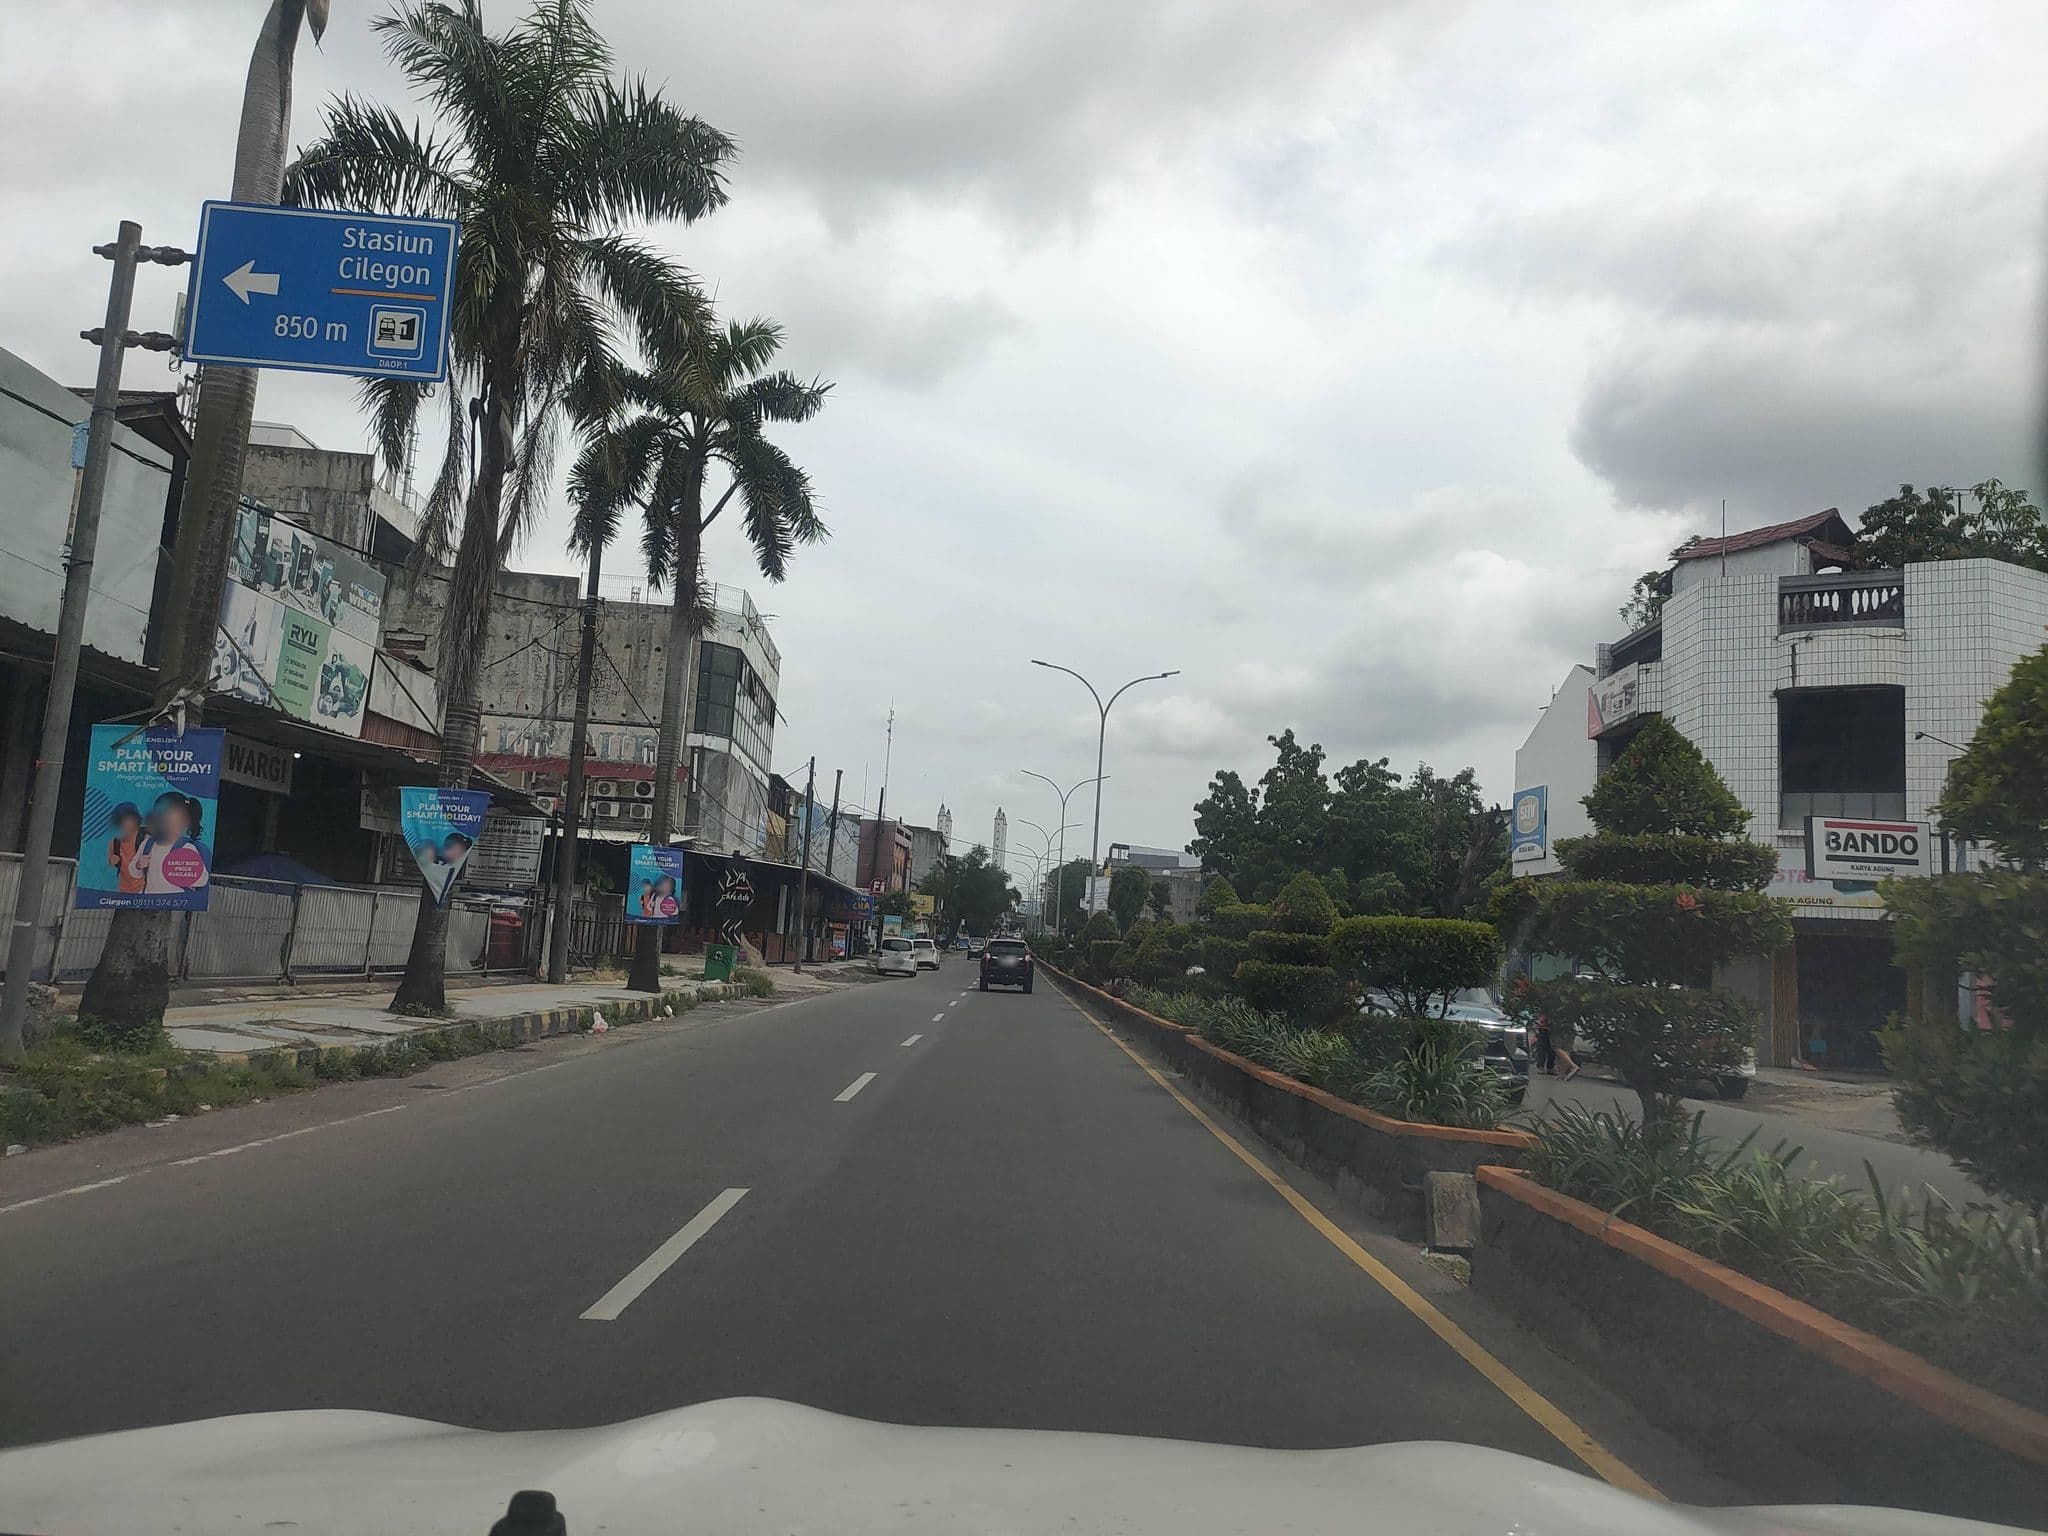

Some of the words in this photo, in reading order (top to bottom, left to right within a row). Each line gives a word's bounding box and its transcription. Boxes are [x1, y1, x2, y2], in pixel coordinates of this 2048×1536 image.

[342, 227, 433, 255] Stasiun
[338, 257, 431, 289] Cilegon
[274, 314, 318, 339] 850
[325, 321, 348, 342] m
[290, 623, 318, 648] RYU
[116, 749, 152, 760] PLAN
[156, 750, 194, 761] YOUR
[229, 744, 288, 784] WARGI
[98, 761, 145, 772] SMART
[147, 762, 212, 774] HOLIDAY!
[406, 811, 438, 819] SMART
[440, 812, 481, 823] HOLIDAY!
[418, 803, 443, 811] PLAN
[445, 804, 470, 813] YOUR
[1825, 831, 1919, 856] BANDO
[99, 898, 131, 906] Cilegon
[173, 899, 189, 907] 577
[1797, 897, 1834, 905] AGUNG
